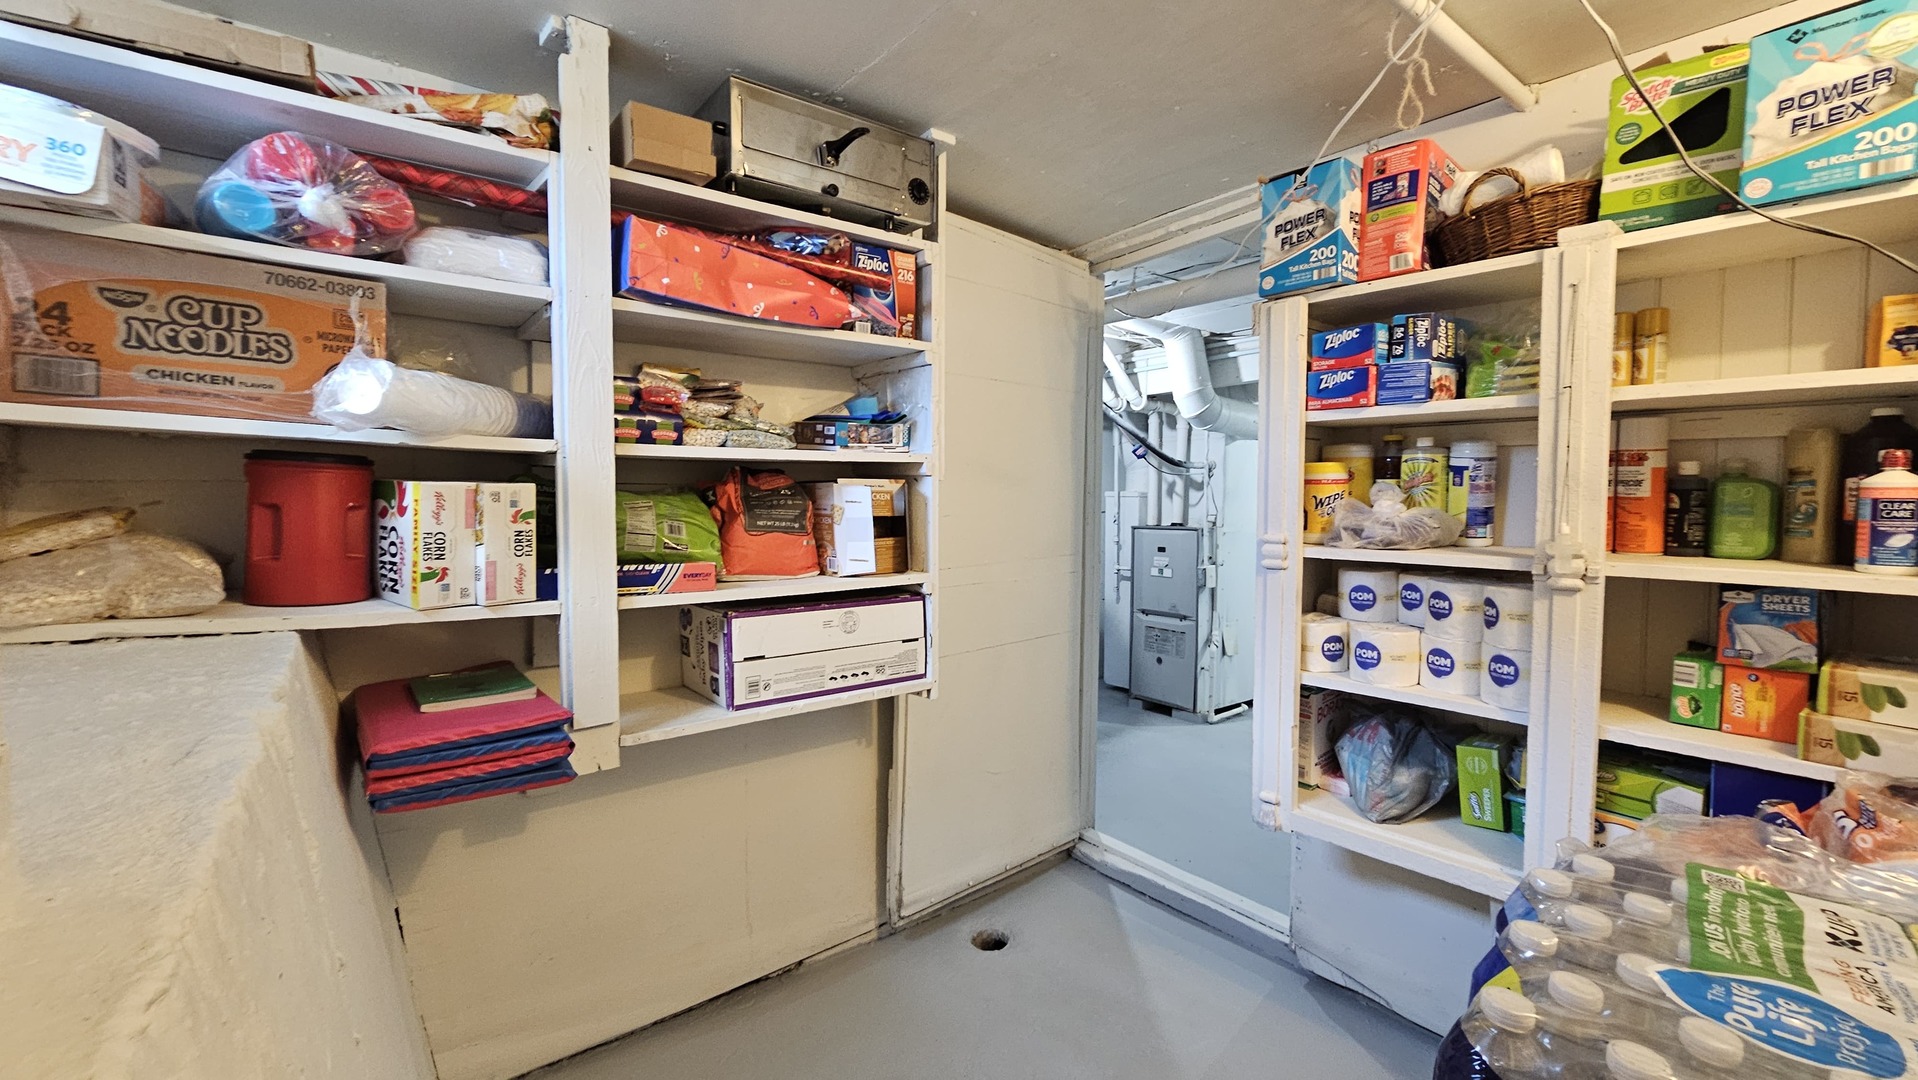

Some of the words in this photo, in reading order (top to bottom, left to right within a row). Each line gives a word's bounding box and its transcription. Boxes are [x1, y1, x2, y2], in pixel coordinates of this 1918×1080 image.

[1684, 72, 1715, 87] HEAVY
[1716, 68, 1742, 81] DUTY
[1776, 65, 1897, 119] POWER
[1789, 94, 1876, 138] FLEX
[45, 137, 86, 156] 360
[1854, 121, 1917, 151] 200
[1805, 159, 1828, 170] Tall
[1829, 149, 1879, 166] Kitchen
[1879, 142, 1917, 155] Bags
[1274, 208, 1326, 238] POWER
[1280, 225, 1319, 251] FLEX
[857, 255, 889, 273] Ziploc
[1309, 245, 1337, 262] 200
[897, 269, 915, 282] 216
[1299, 261, 1320, 271] Kitchen
[165, 294, 263, 333] CUP
[122, 315, 293, 365] NOODLES
[1324, 328, 1361, 350] Ziploc
[1415, 319, 1430, 347] Ziploc
[1437, 319, 1448, 354] Ziploc
[64, 341, 96, 354] OZ
[1313, 359, 1336, 367] STORAGE
[145, 368, 236, 386] CHICKEN
[238, 381, 275, 390] FLAVOR
[1319, 370, 1355, 390] Ziploc
[432, 490, 448, 527] Kellogg's
[1311, 489, 1346, 510] WIPE
[1878, 502, 1917, 510] CLEAR
[1881, 510, 1914, 518] CARE
[412, 498, 420, 553] FAMILY
[422, 531, 434, 563] FLAKES
[433, 530, 447, 562] CORN
[514, 529, 526, 559] CORN
[524, 528, 534, 558] FLAKES
[377, 525, 390, 593] FLAKES
[387, 525, 400, 595] CORN
[512, 562, 528, 596] Kellogg's
[683, 572, 712, 580] EVERYDAY
[1350, 592, 1373, 601] POM
[1401, 590, 1420, 600] POM
[1429, 598, 1450, 610] POM
[1761, 594, 1811, 605] DRYER
[1484, 606, 1496, 617] OM
[1761, 602, 1812, 613] SHEETS
[1323, 642, 1343, 652] POM
[1356, 648, 1378, 660] POM
[1428, 655, 1451, 667] POM
[1490, 662, 1515, 675] POM
[1729, 683, 1745, 718] bounce
[1844, 691, 1859, 702] 15
[1819, 738, 1833, 750] 15
[1482, 787, 1493, 822] SWEEPER
[1706, 983, 1727, 1003] The
[1723, 981, 1768, 1037] Pure
[1766, 997, 1829, 1047] Life
